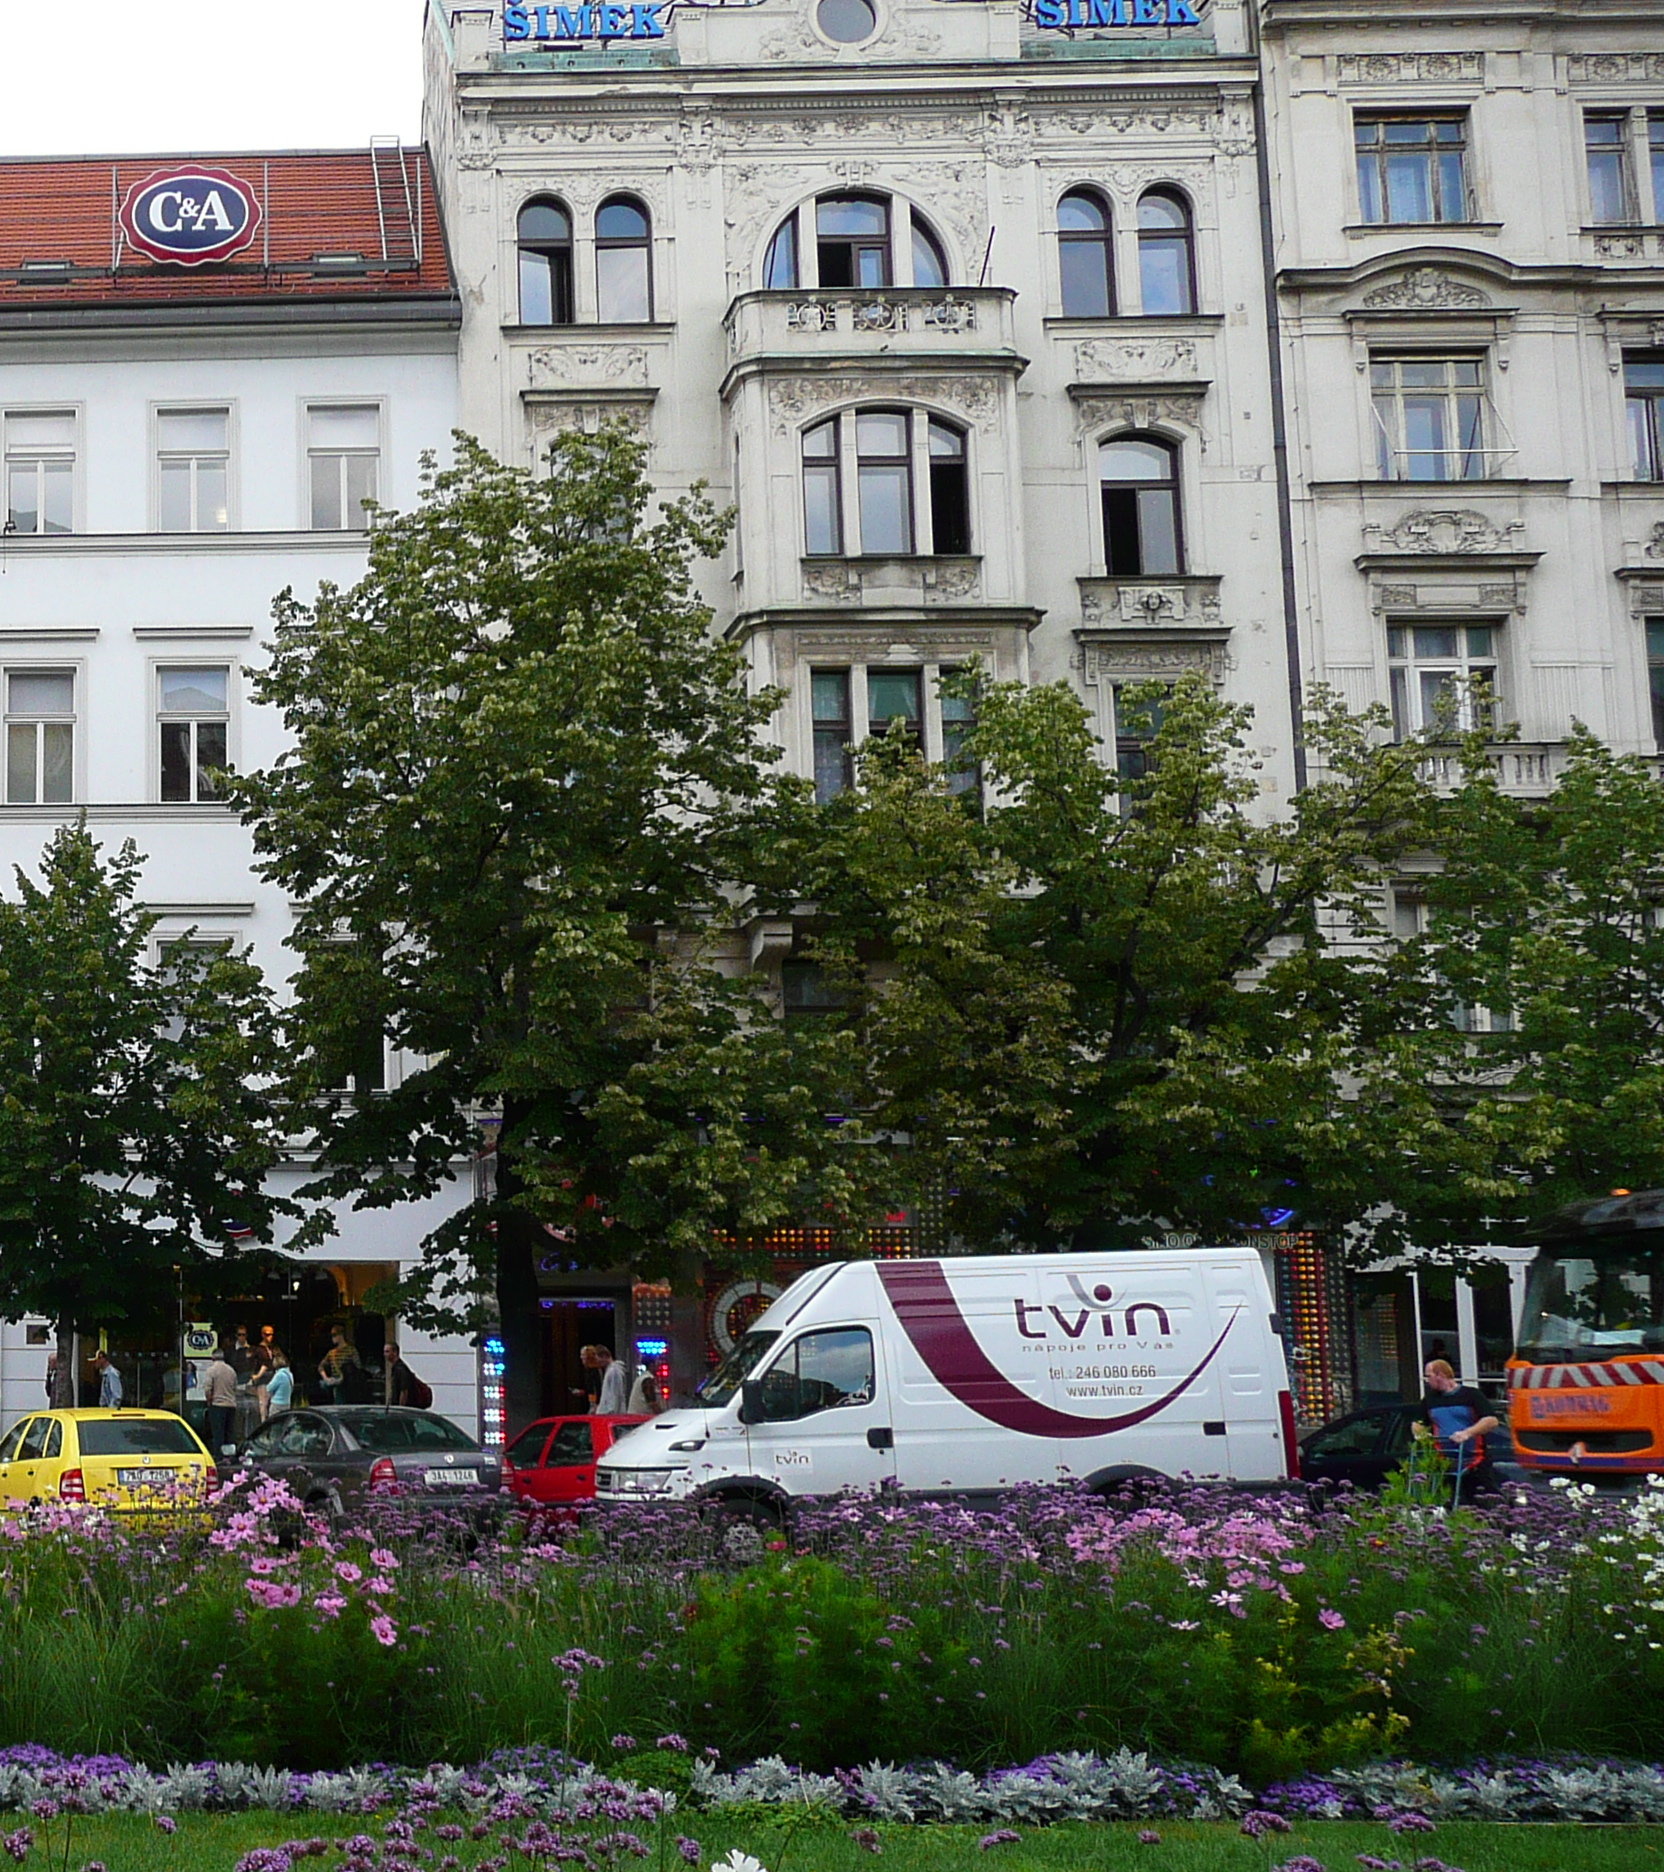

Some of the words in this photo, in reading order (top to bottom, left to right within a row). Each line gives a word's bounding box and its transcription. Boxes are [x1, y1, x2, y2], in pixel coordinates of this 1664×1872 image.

[148, 190, 235, 232] C&A
[1013, 1284, 1172, 1339] tvin
[1096, 1342, 1127, 1352] pro
[1076, 1366, 1101, 1379] 246
[1103, 1365, 1128, 1379] 080
[1131, 1365, 1157, 1378] 666
[1066, 1383, 1144, 1398] www.tvin.cz
[776, 1451, 809, 1465] tvin
